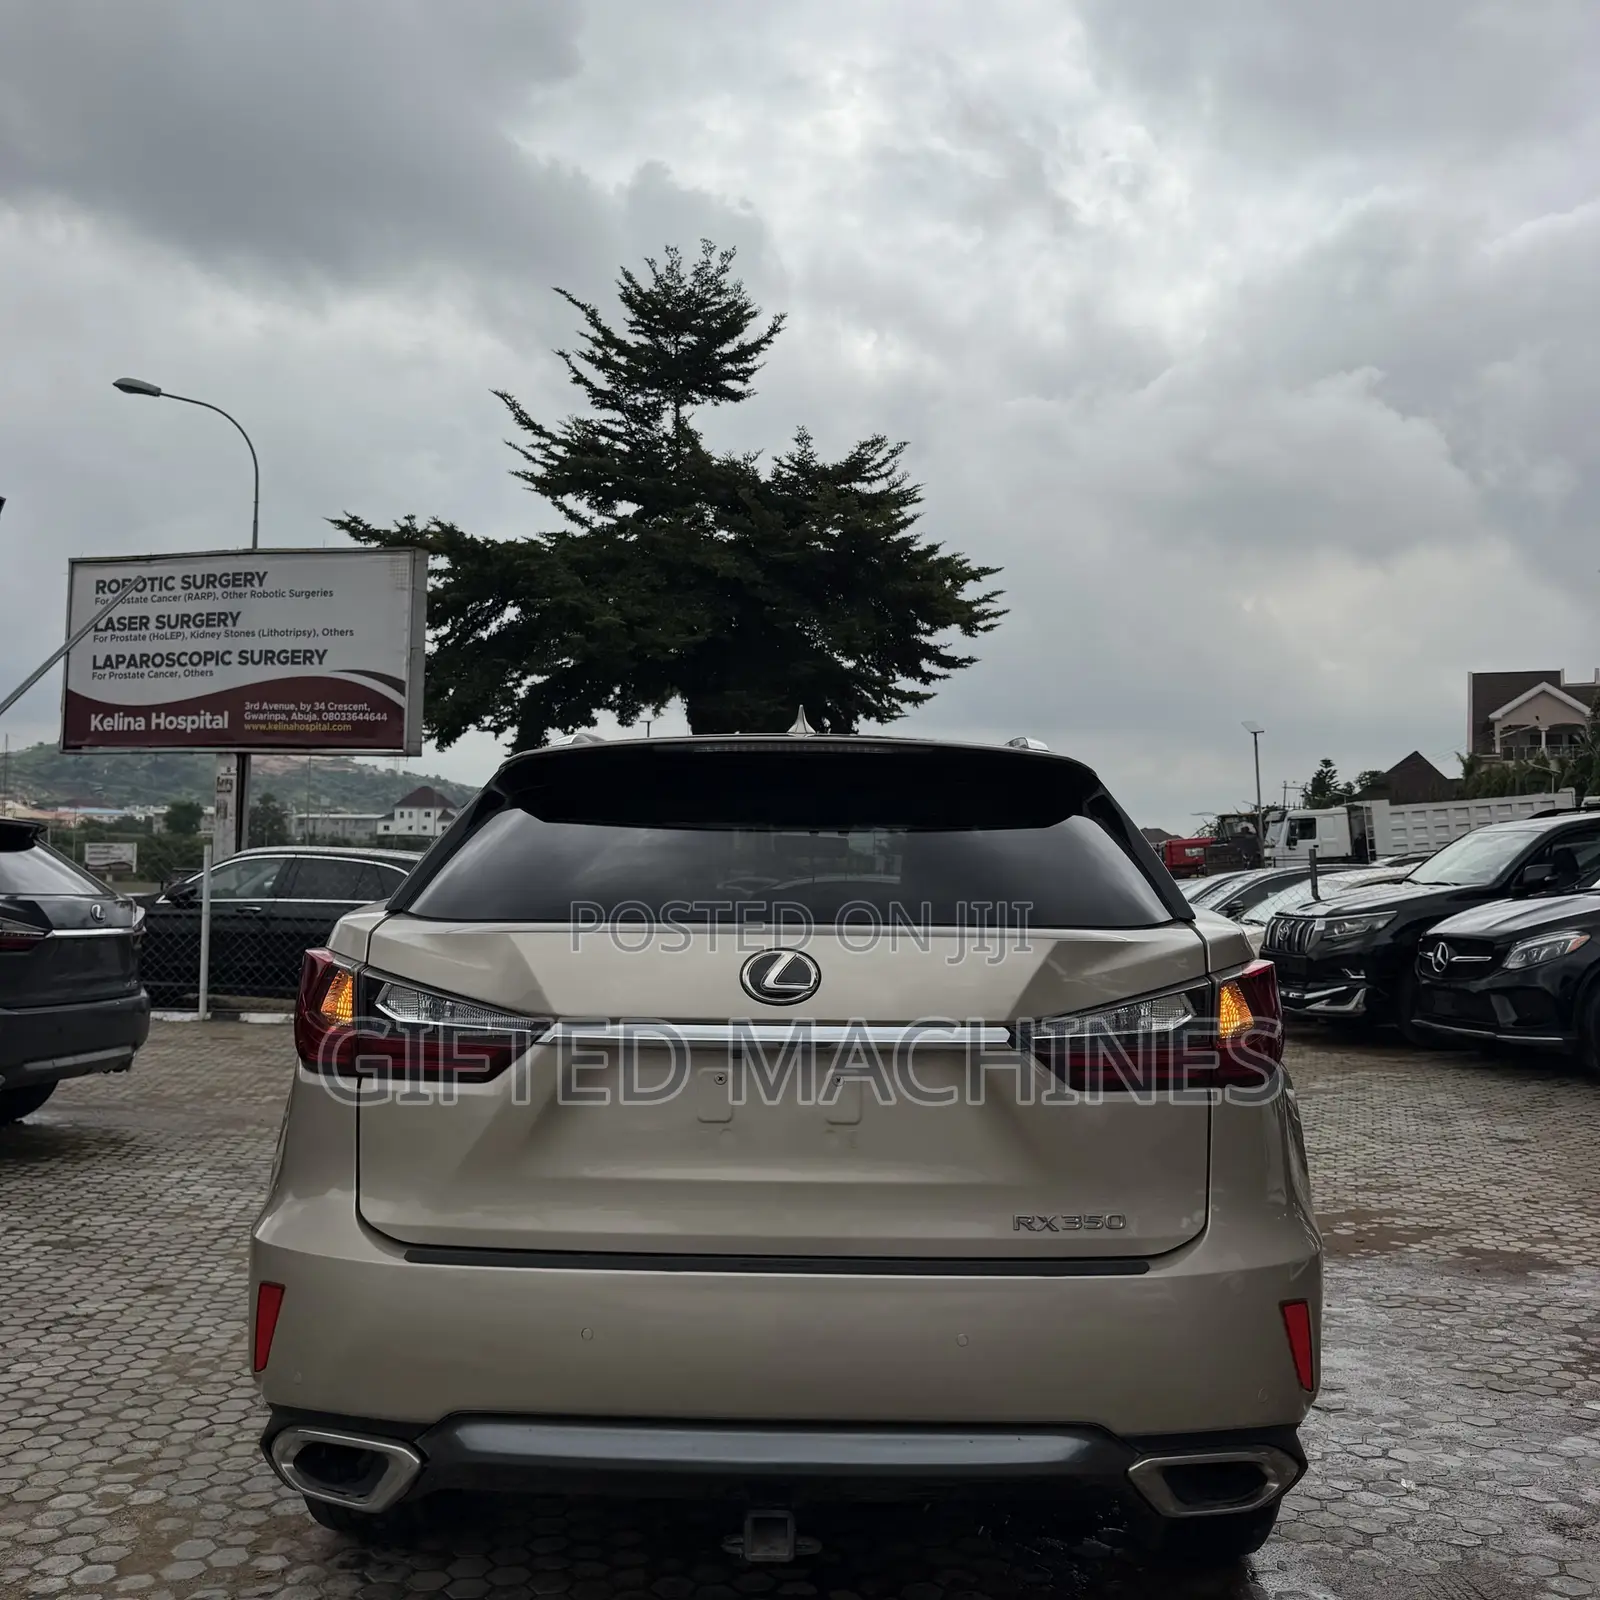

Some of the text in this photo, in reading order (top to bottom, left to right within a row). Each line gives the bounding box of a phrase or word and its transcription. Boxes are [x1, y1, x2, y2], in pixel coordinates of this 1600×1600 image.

[181, 571, 268, 590] SURGERY
[95, 588, 334, 605] For ostate Cancer (RARP), Other Robotic Surgeries
[94, 611, 242, 632] LASER SURGERY
[94, 628, 354, 643] For Prostate (HoLEP), Kidney Stones (Lithotripsy), Others
[92, 649, 328, 670] LAPAROSCOPIC SURGERY
[92, 668, 214, 680] For Prostate Cancer, Others
[244, 702, 370, 711] 3rd Avenue, by 34 Crescent,
[90, 710, 229, 733] Kelina Hospital
[244, 712, 288, 721] Gwarinpa,
[322, 712, 387, 721] 08033644644
[244, 722, 352, 732] www.kelinahospital.com
